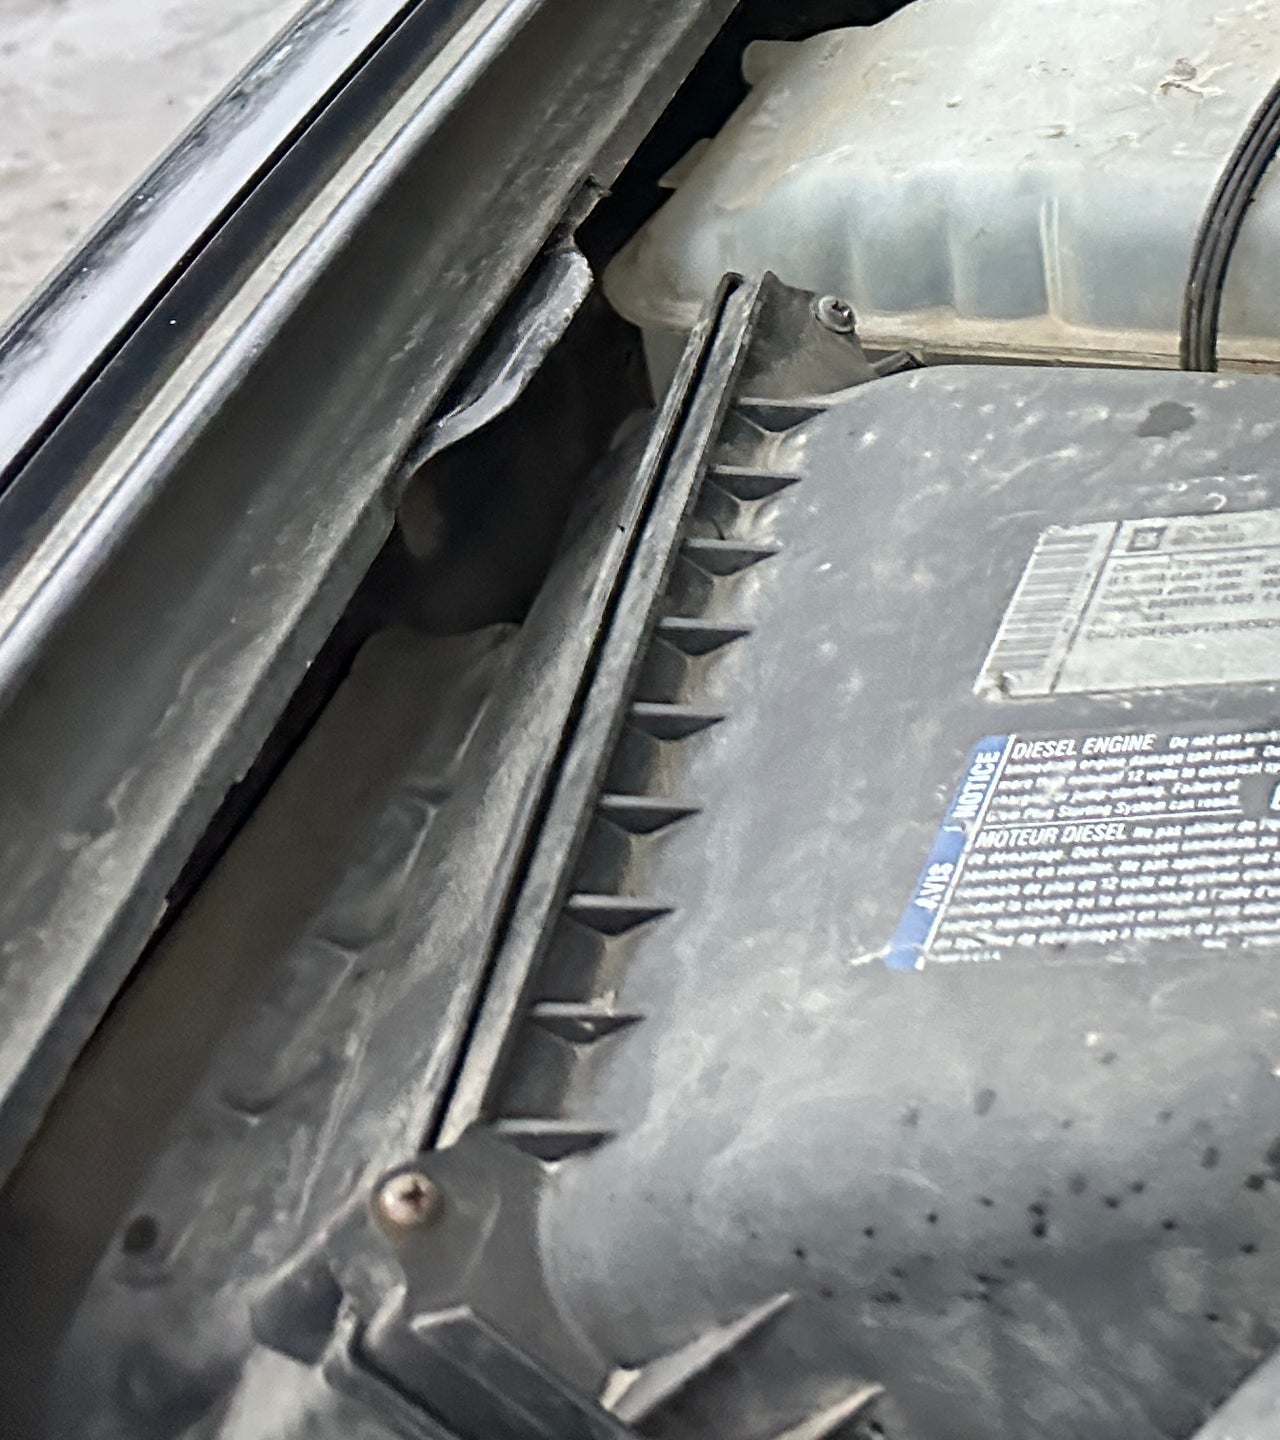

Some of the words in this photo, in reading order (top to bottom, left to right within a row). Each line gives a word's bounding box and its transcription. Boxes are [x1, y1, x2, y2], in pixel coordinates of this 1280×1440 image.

[1010, 739, 1078, 760] DIESEL
[1081, 733, 1158, 755] ENGINE
[951, 750, 1001, 819] NOTICE
[1127, 768, 1145, 782] 12
[973, 826, 1060, 850] MOTEUR
[1060, 823, 1129, 844] DIESEL
